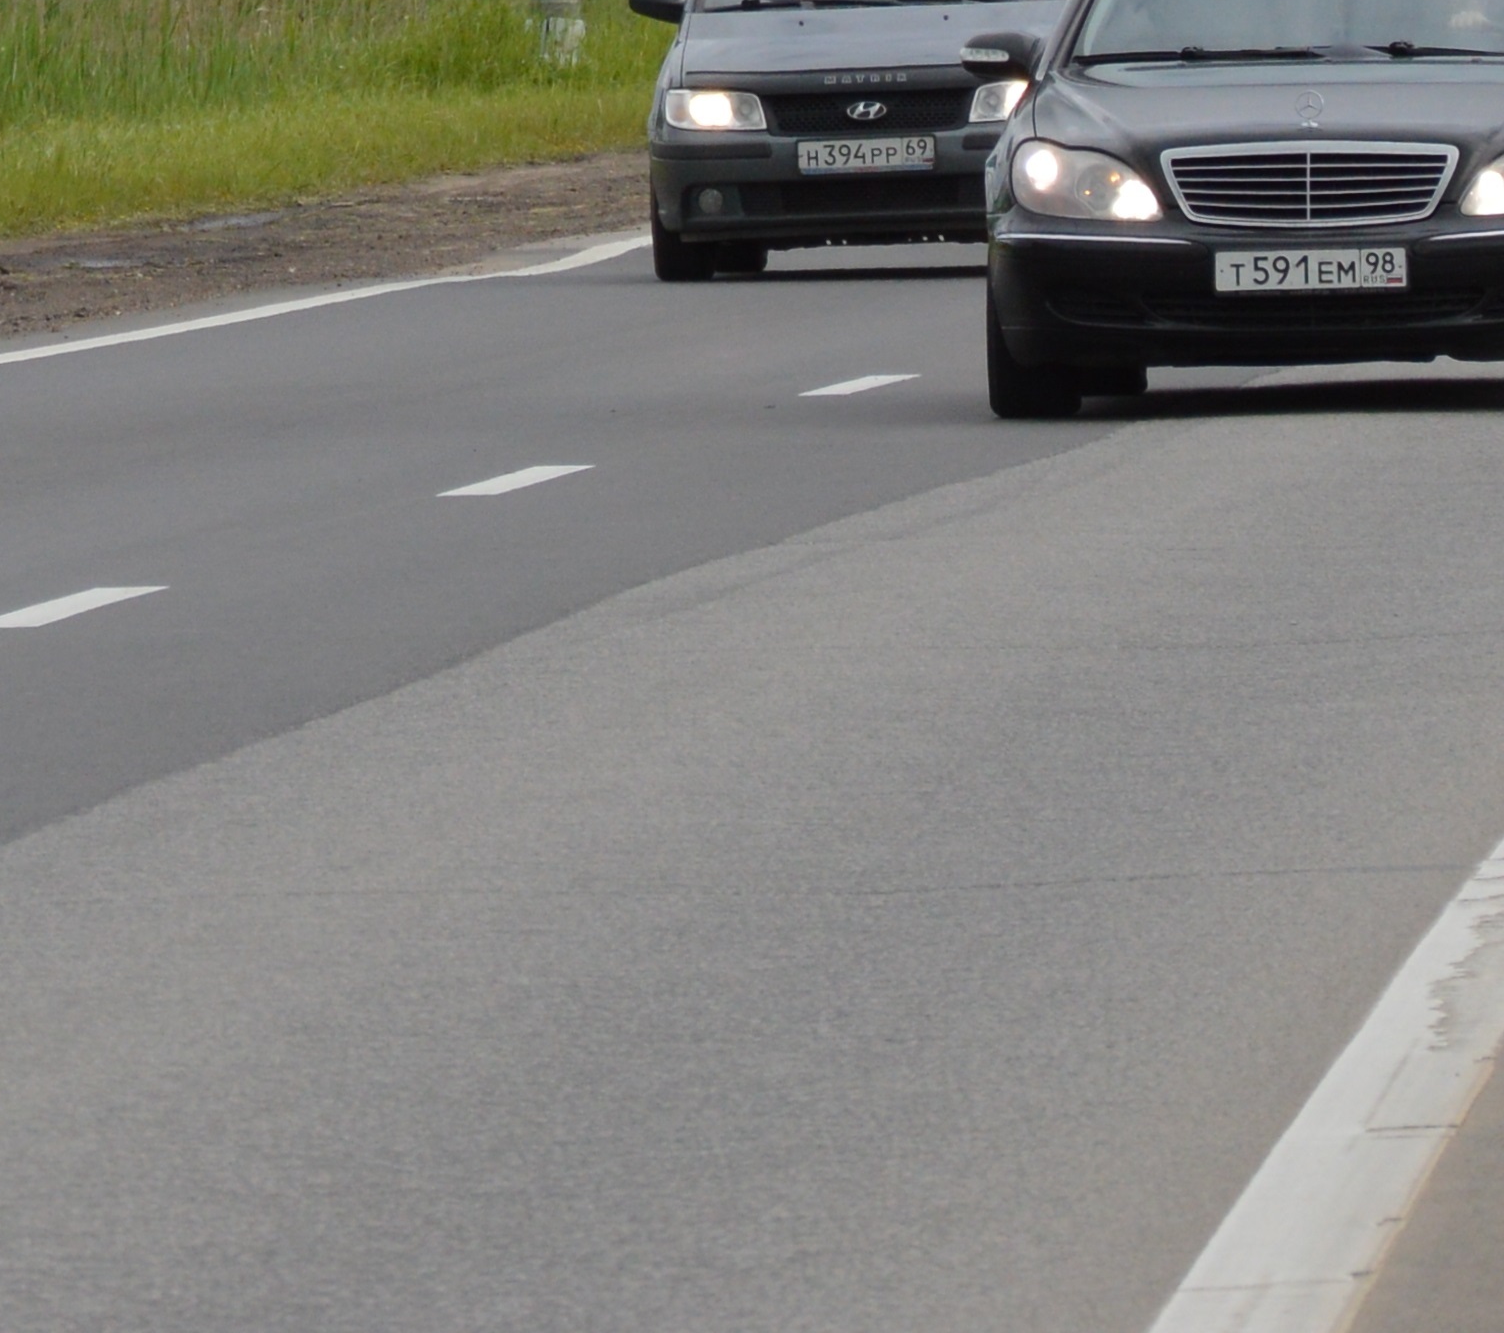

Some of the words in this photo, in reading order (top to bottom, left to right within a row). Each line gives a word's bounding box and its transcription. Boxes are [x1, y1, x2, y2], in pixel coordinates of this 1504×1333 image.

[807, 144, 897, 166] Н394РР
[905, 139, 927, 155] 69
[1230, 255, 1356, 286] Т591ЕМ
[1365, 252, 1395, 274] 98
[1363, 275, 1386, 283] RUS
